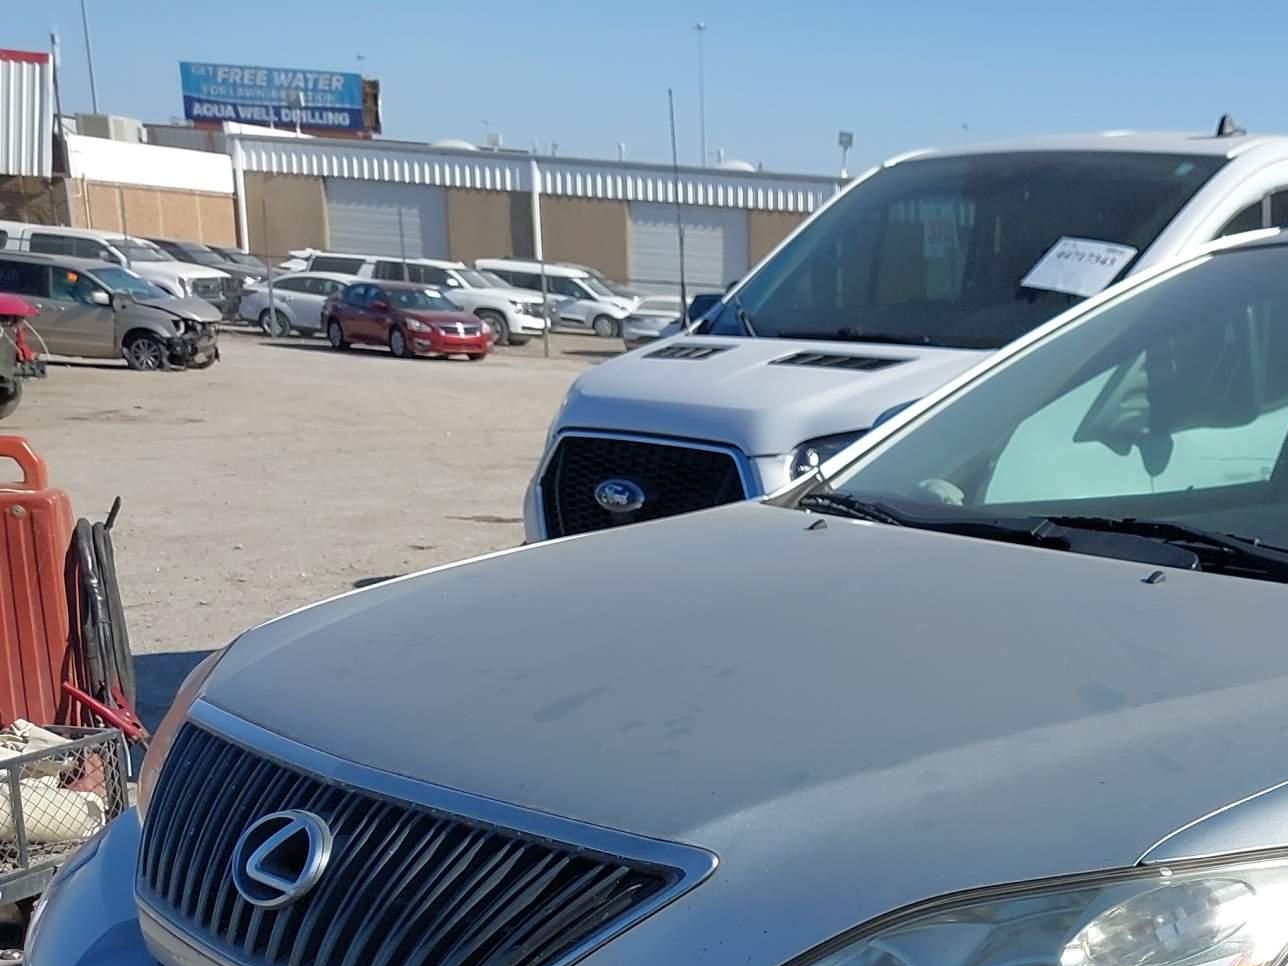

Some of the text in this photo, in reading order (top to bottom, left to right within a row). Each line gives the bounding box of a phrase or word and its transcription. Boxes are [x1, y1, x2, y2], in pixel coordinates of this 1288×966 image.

[203, 85, 229, 96] FOR
[216, 68, 268, 87] FREE
[271, 72, 344, 91] WATER
[192, 102, 350, 127] AQUA WELL DRILLING
